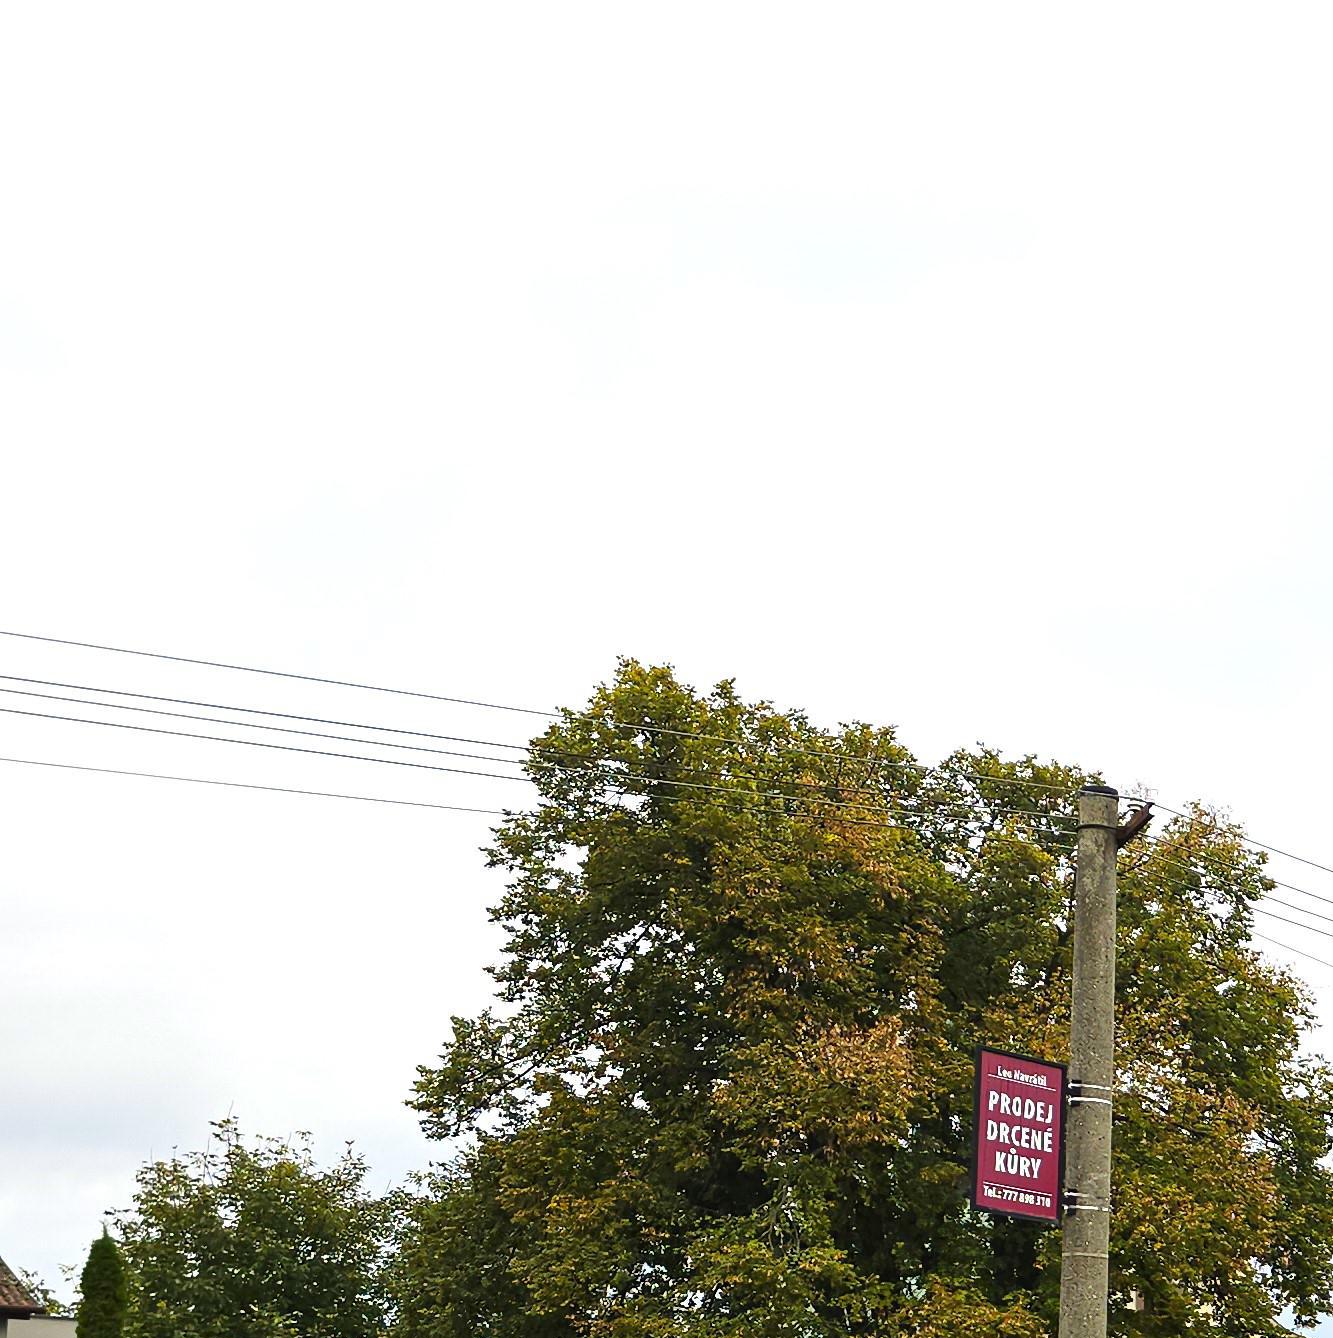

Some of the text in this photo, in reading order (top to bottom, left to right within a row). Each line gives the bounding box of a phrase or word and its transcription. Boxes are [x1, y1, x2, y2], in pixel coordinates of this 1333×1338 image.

[988, 1090, 1053, 1124] PRODEJ
[986, 1119, 1053, 1153] DRCENÉ
[994, 1147, 1042, 1179] KŮRY
[1002, 1189, 1019, 1202] 777
